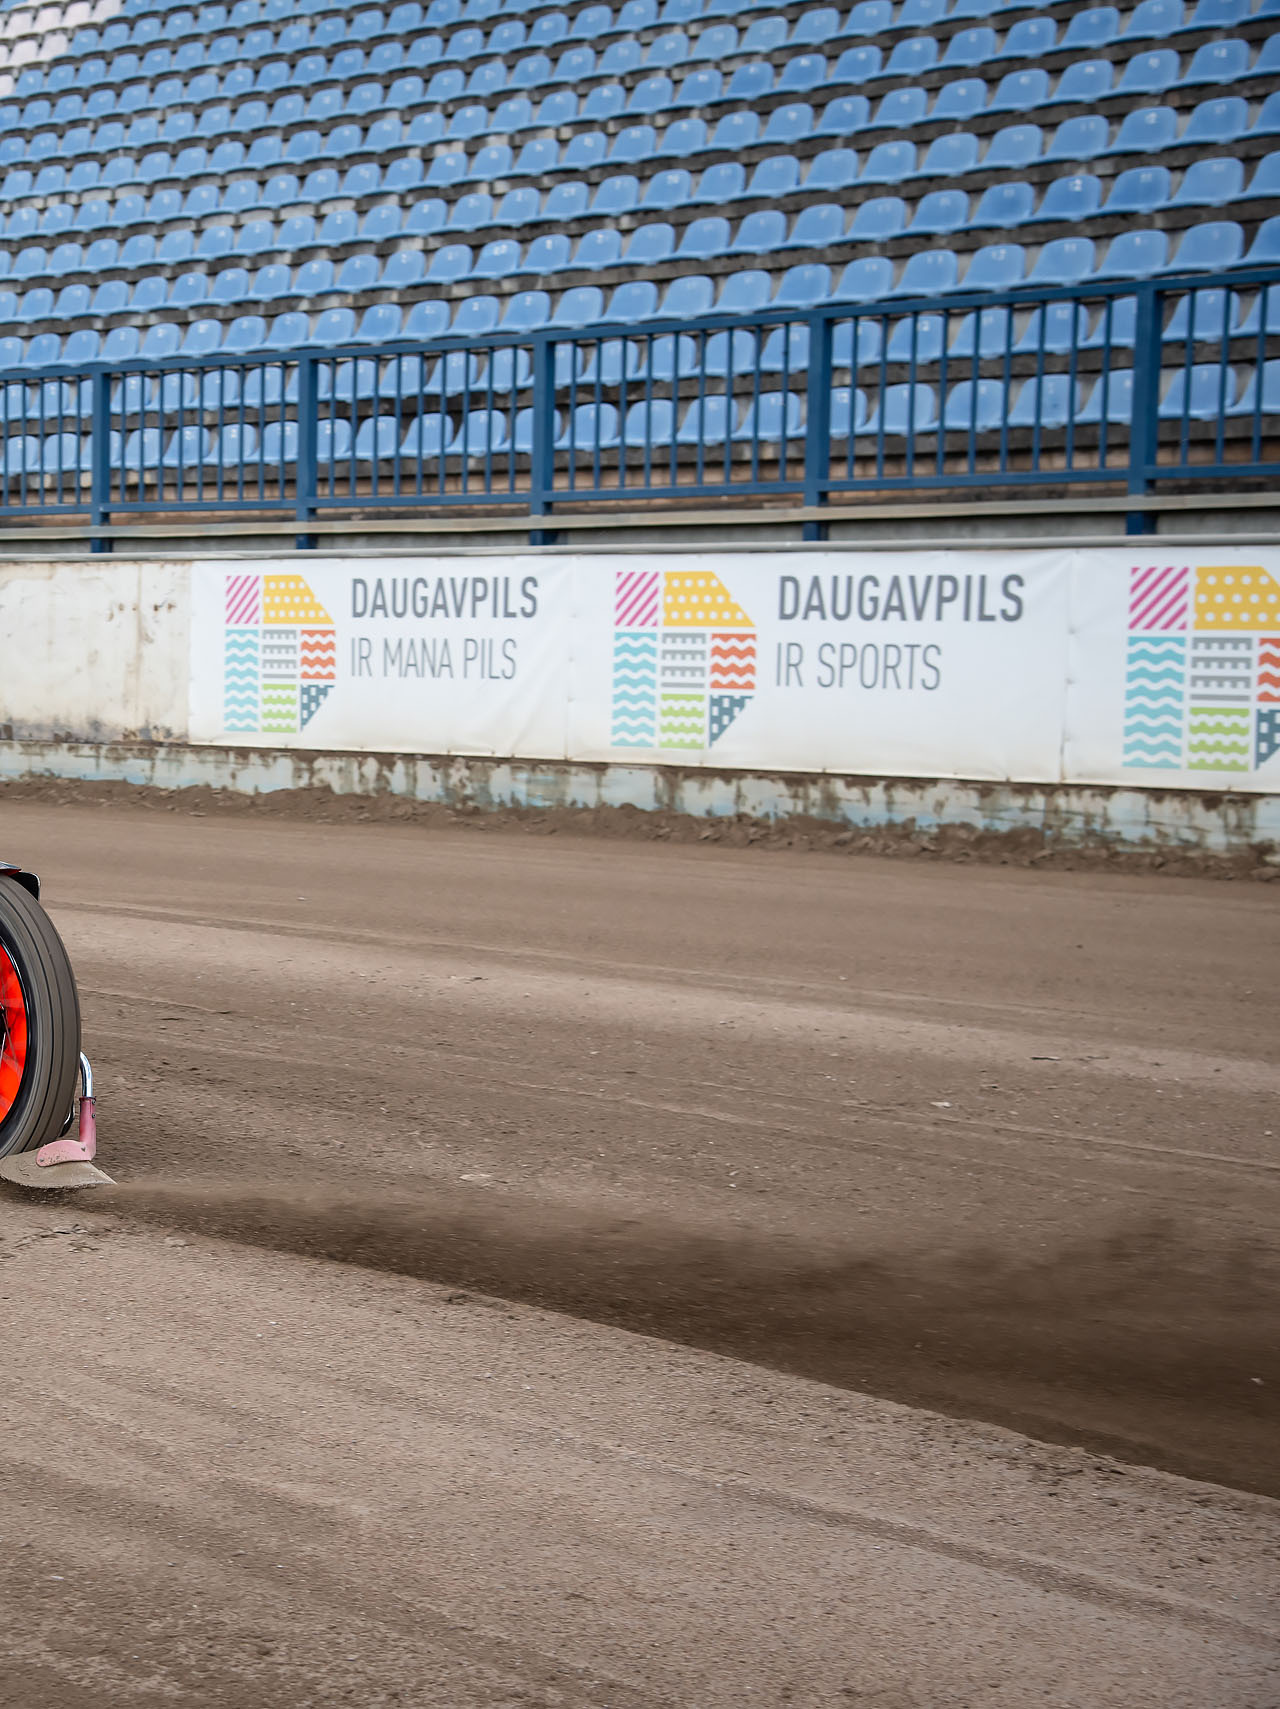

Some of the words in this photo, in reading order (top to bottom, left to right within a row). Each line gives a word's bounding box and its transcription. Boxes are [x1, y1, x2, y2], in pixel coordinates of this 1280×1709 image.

[350, 576, 539, 619] DAUGAVPILS
[777, 574, 1026, 622] DAUGAVPILS
[350, 637, 373, 678] IR
[382, 637, 454, 679] MANA
[463, 638, 517, 680] PILS
[775, 642, 804, 687] IR
[817, 643, 942, 690] SPORTS
